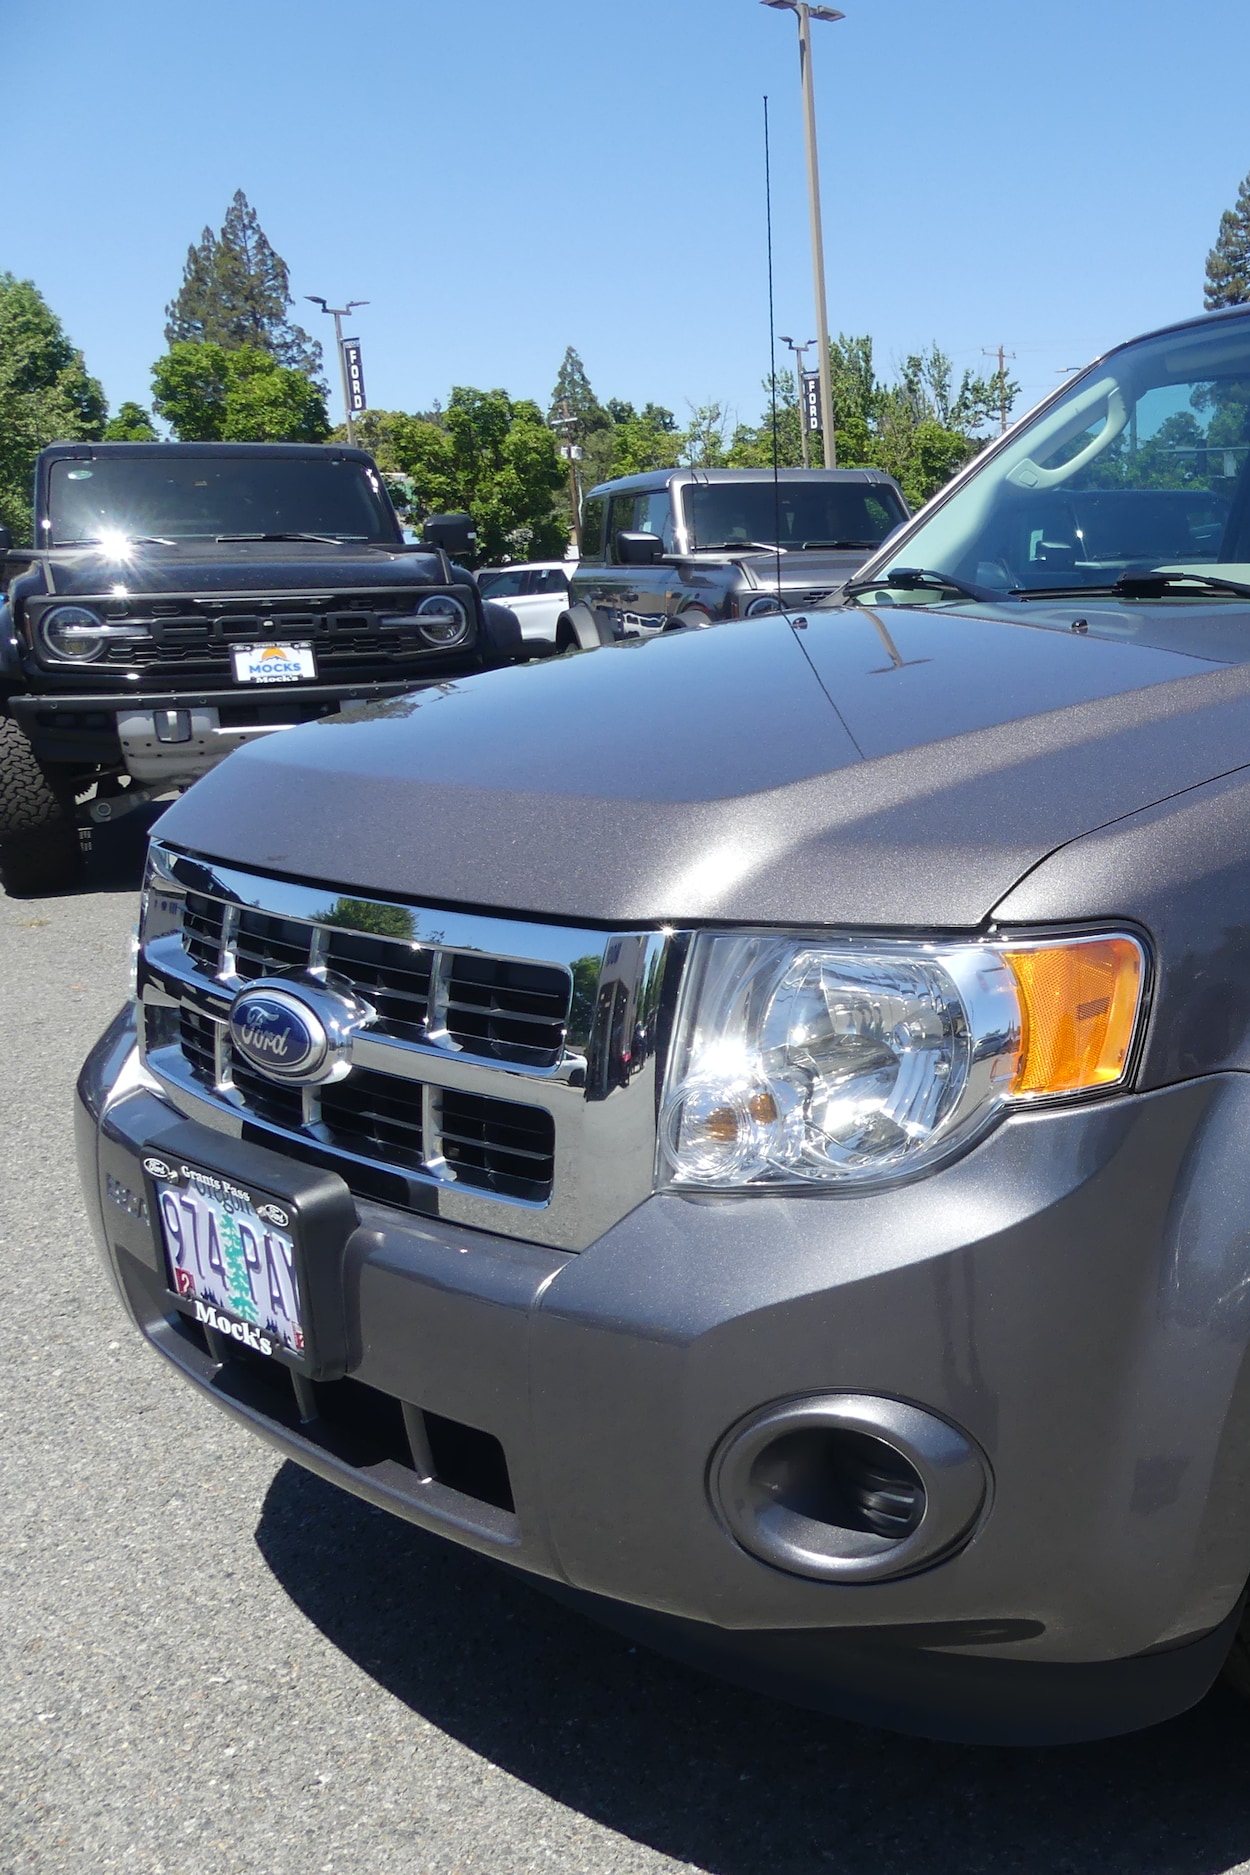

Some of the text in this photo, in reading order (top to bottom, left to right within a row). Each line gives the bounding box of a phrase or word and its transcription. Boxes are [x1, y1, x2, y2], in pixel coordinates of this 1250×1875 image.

[349, 349, 362, 409] FORD
[808, 380, 818, 430] FORD
[248, 662, 302, 674] MOCKS
[241, 1006, 291, 1056] Ford
[181, 1165, 251, 1202] Grants Pass
[194, 1300, 272, 1356] Mock's
